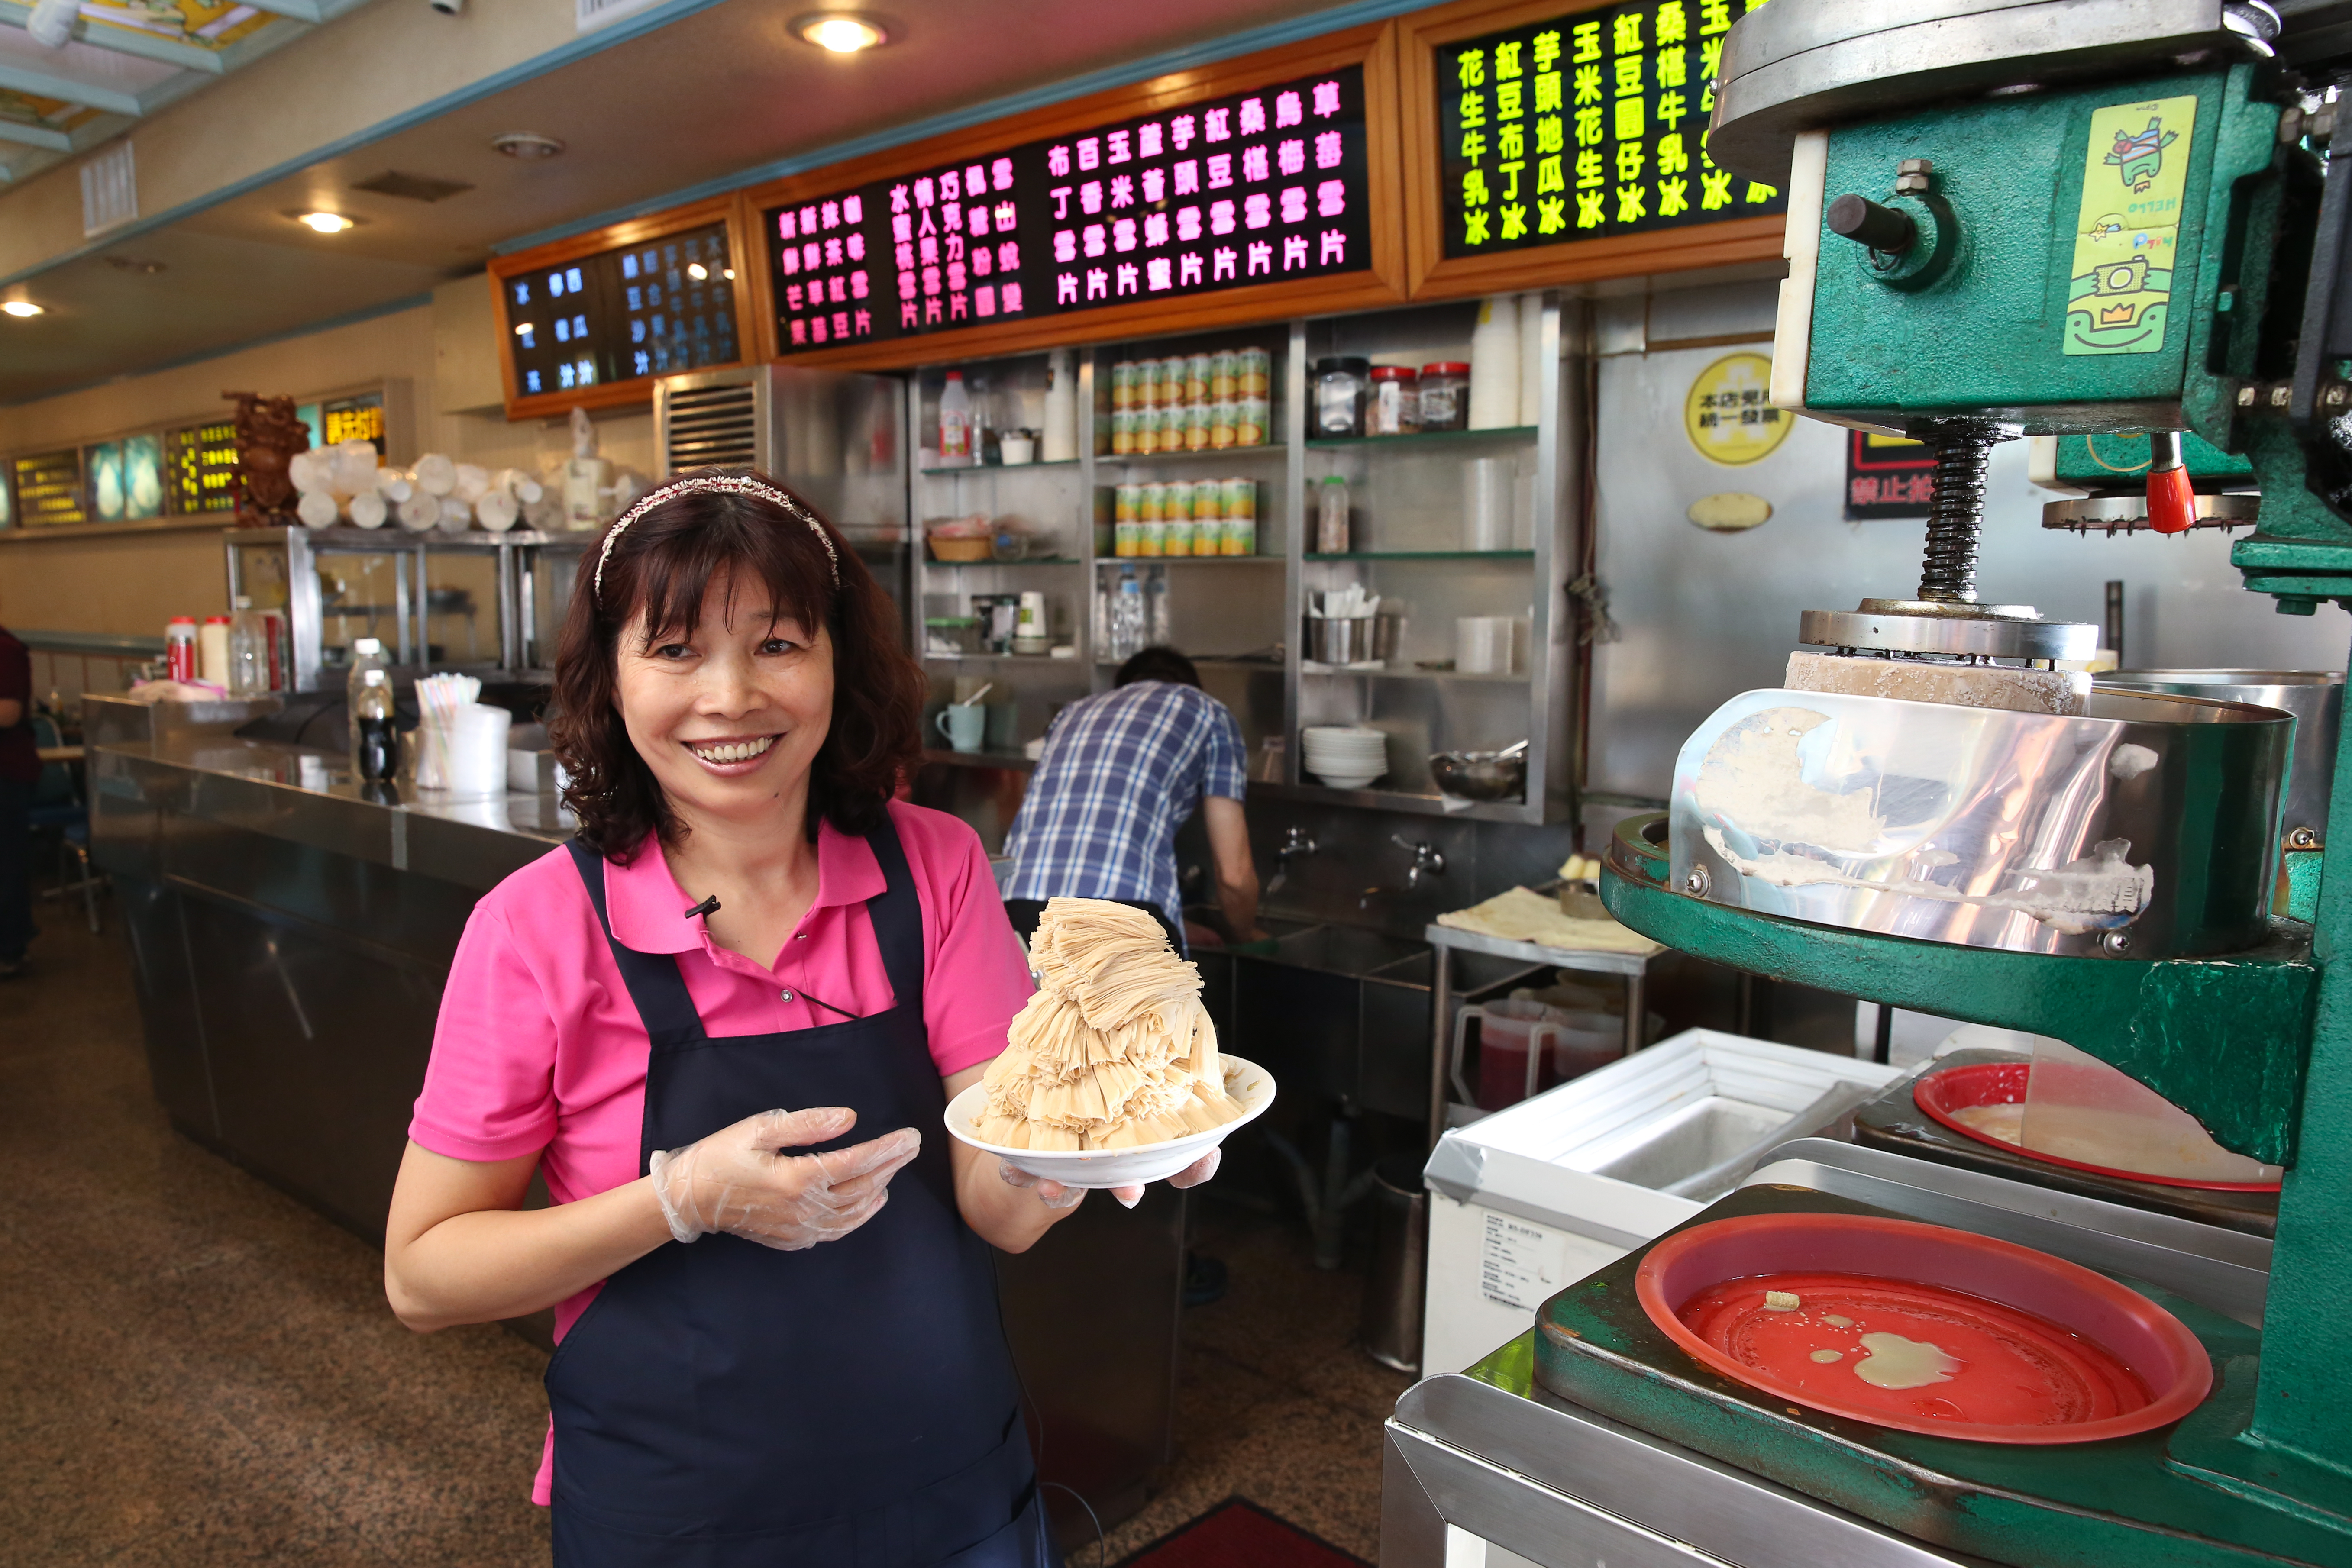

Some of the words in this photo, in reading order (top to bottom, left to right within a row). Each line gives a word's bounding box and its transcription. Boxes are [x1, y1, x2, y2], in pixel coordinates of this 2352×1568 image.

[1240, 98, 1272, 276] 桑椹雪片
[1276, 91, 1308, 271] 烏梅雪片
[1313, 81, 1346, 266] 草莓雪片
[1457, 48, 1490, 246] 花生牛乳冰
[1495, 41, 1527, 240] 紅豆布丁冰
[1533, 29, 1565, 234] 芋頭地瓜冰
[1573, 21, 1605, 229] 玉米花生冰
[1613, 13, 1646, 223] 紅豆圓仔冰
[1655, 1, 1688, 217] 桑椹牛乳冰
[1699, 0, 1732, 210] 玉米冰
[890, 184, 918, 329] 水蜜桃雪片
[914, 177, 943, 325] 情人果雪片
[939, 171, 968, 321] 巧克力雪片
[1048, 145, 1078, 304] 布丁雪片
[1076, 137, 1108, 300] 百香雪片
[1108, 130, 1138, 296] 玉米雪片
[1171, 114, 1203, 286] 芋頭雪片
[1205, 108, 1237, 281] 紅豆雪片
[2128, 197, 2177, 214] HELLO
